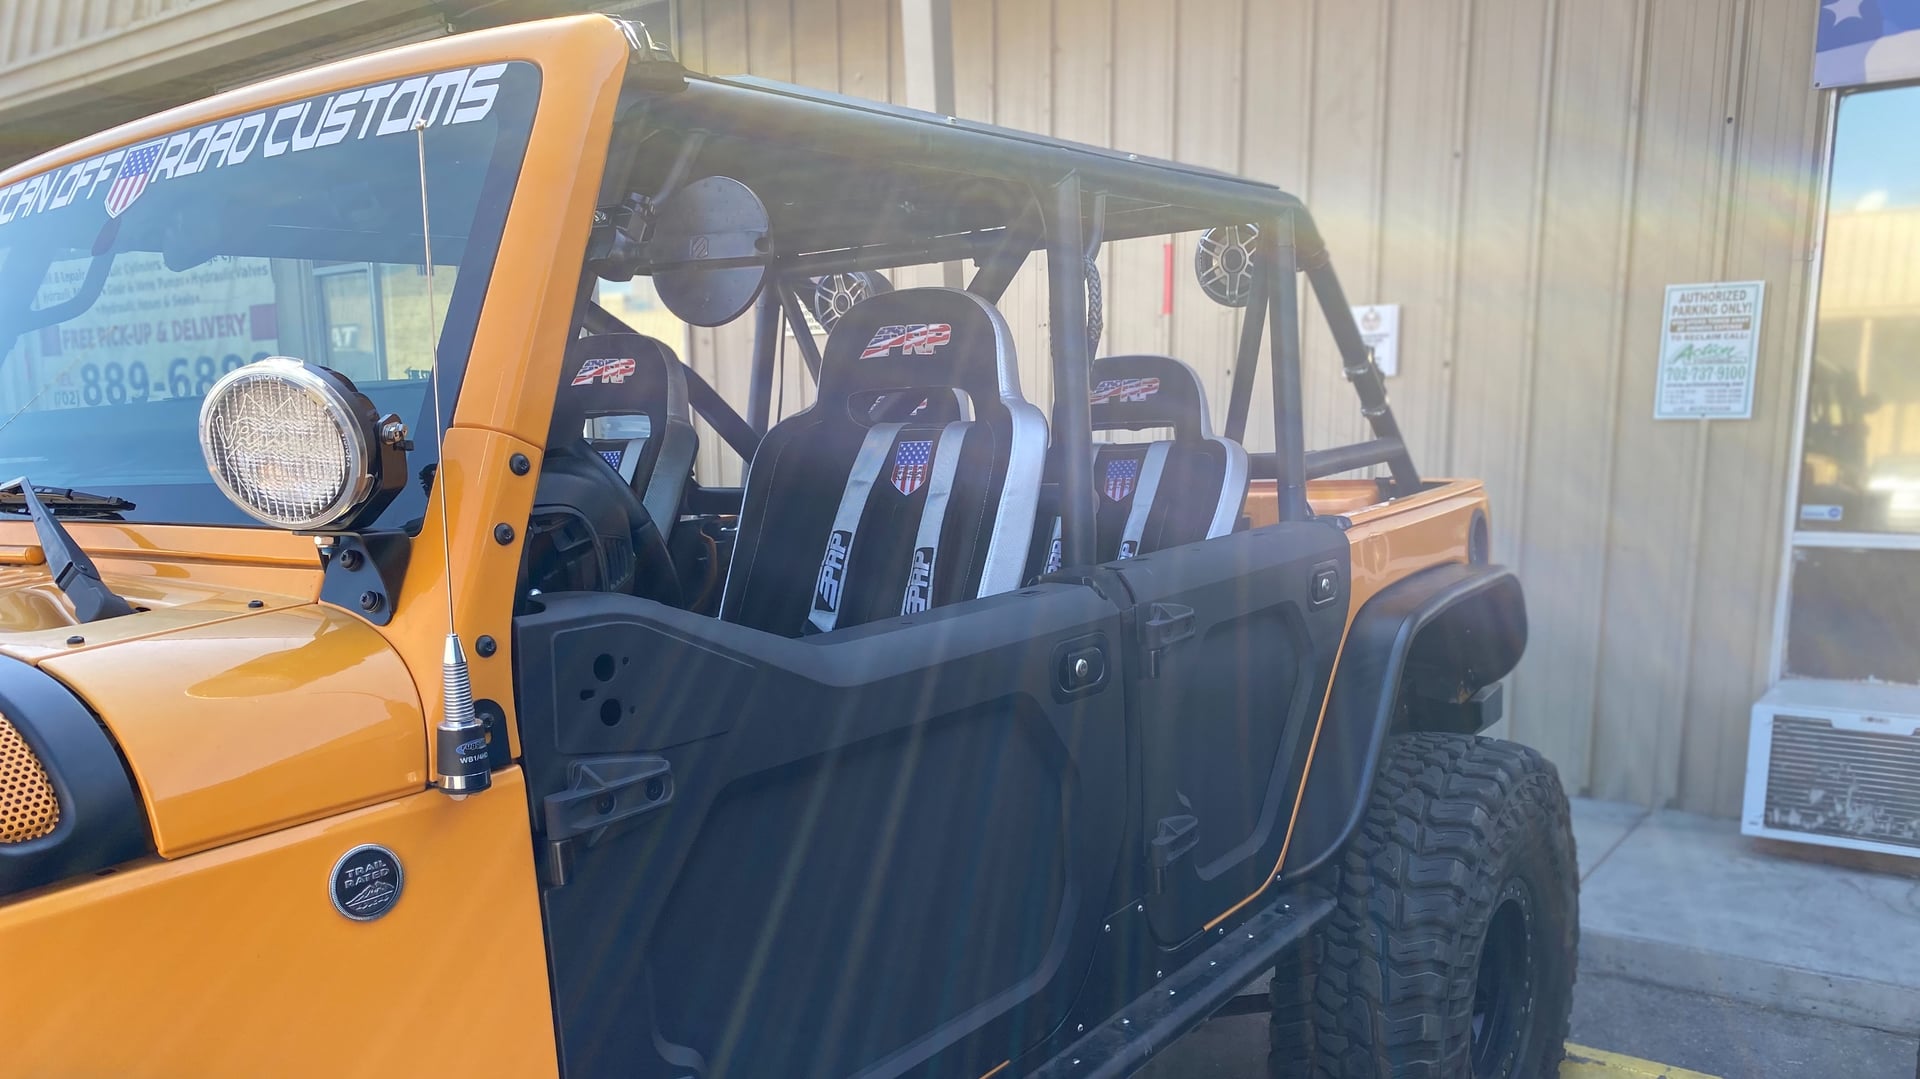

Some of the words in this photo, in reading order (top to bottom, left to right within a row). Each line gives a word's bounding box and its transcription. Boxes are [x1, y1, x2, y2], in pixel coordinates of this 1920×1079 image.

[49, 149, 126, 211] OFF
[151, 113, 265, 183] ROAD
[264, 63, 508, 158] CUSTOMS
[1679, 289, 1747, 303] AUTHORIZED
[1671, 304, 1717, 317] PARKING
[1720, 302, 1753, 315] ONLY!
[63, 327, 95, 350] FREE
[97, 322, 151, 349] PICK-UP
[156, 325, 168, 343] &
[172, 312, 247, 341] DELIVERY
[859, 323, 952, 360] PRP
[1673, 343, 1736, 363] Action
[570, 358, 636, 386] PRP
[344, 868, 390, 889] RATED
[345, 860, 386, 878] TRAIL
